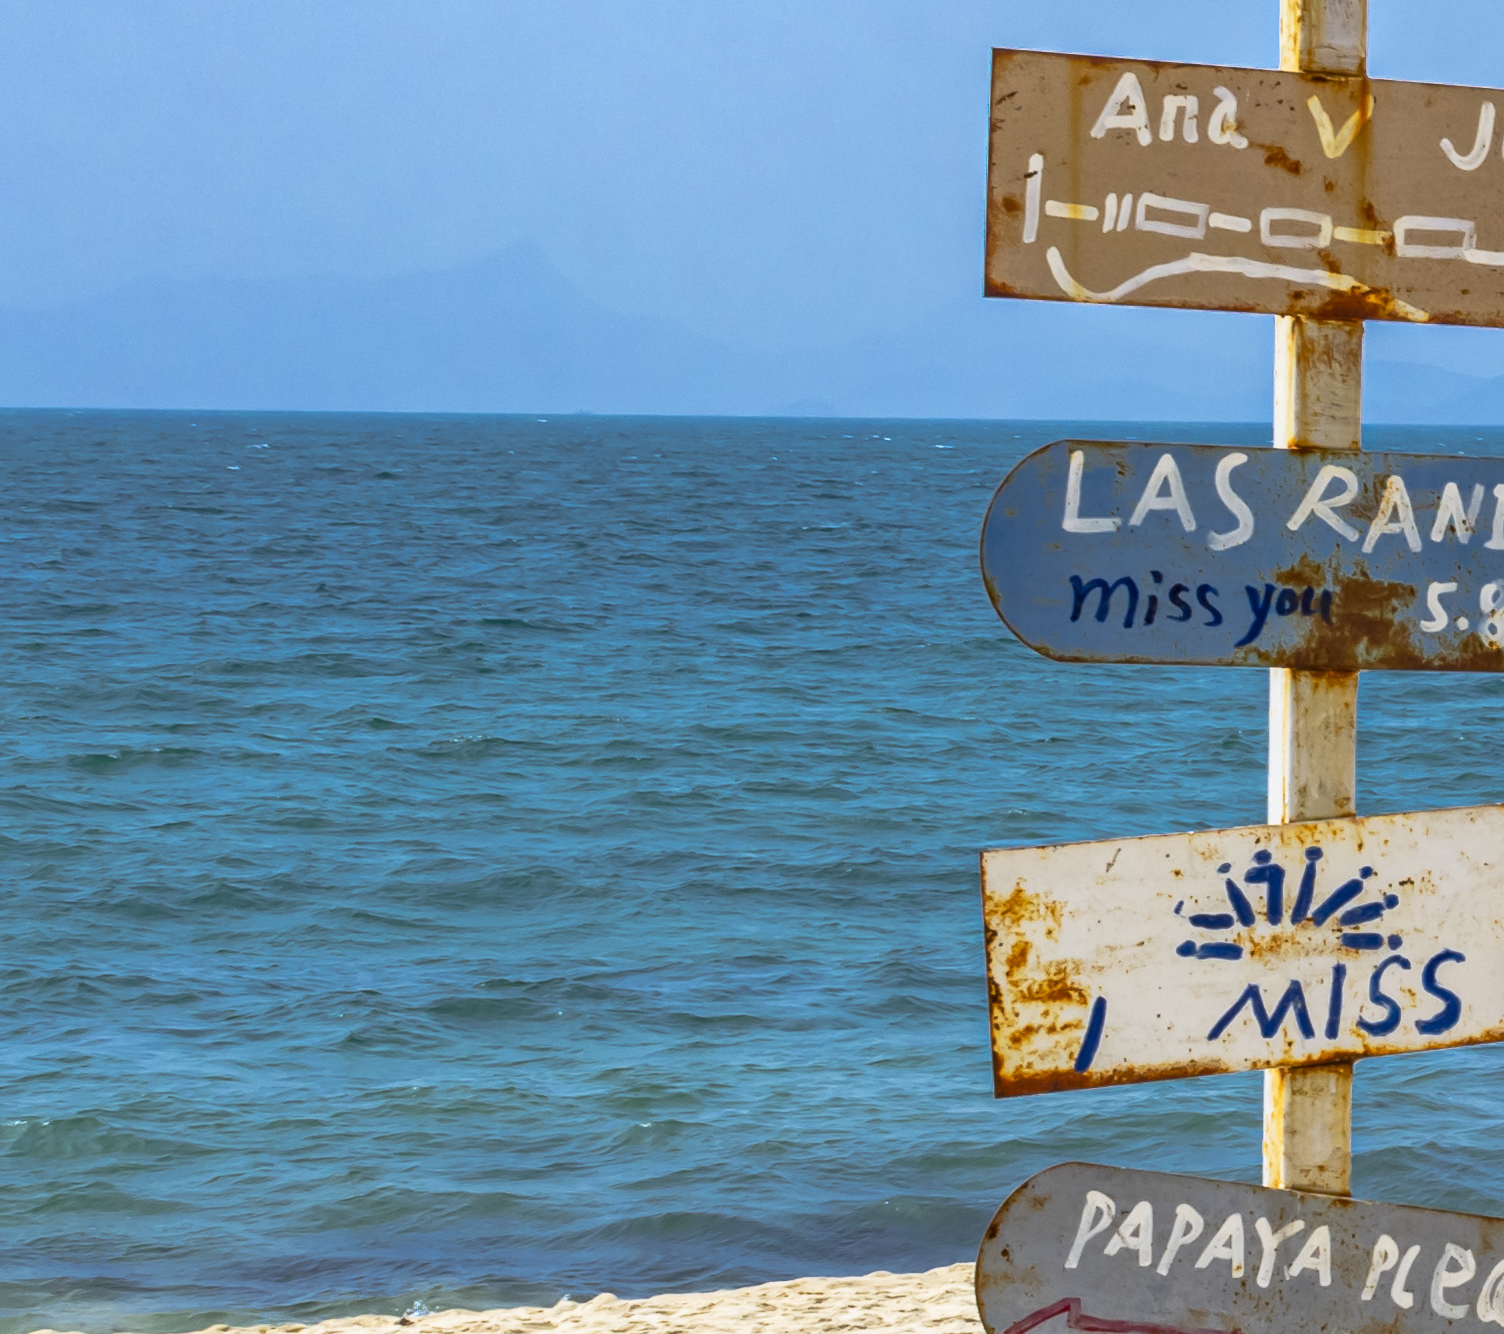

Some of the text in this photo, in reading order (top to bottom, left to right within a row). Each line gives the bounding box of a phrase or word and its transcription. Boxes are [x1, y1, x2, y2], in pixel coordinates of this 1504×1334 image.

[1091, 72, 1249, 149] Ana
[1062, 450, 1256, 551] LAS
[1234, 584, 1333, 648] you
[1207, 948, 1466, 1042] MISS
[1064, 1189, 1332, 1288] PAPAYA
